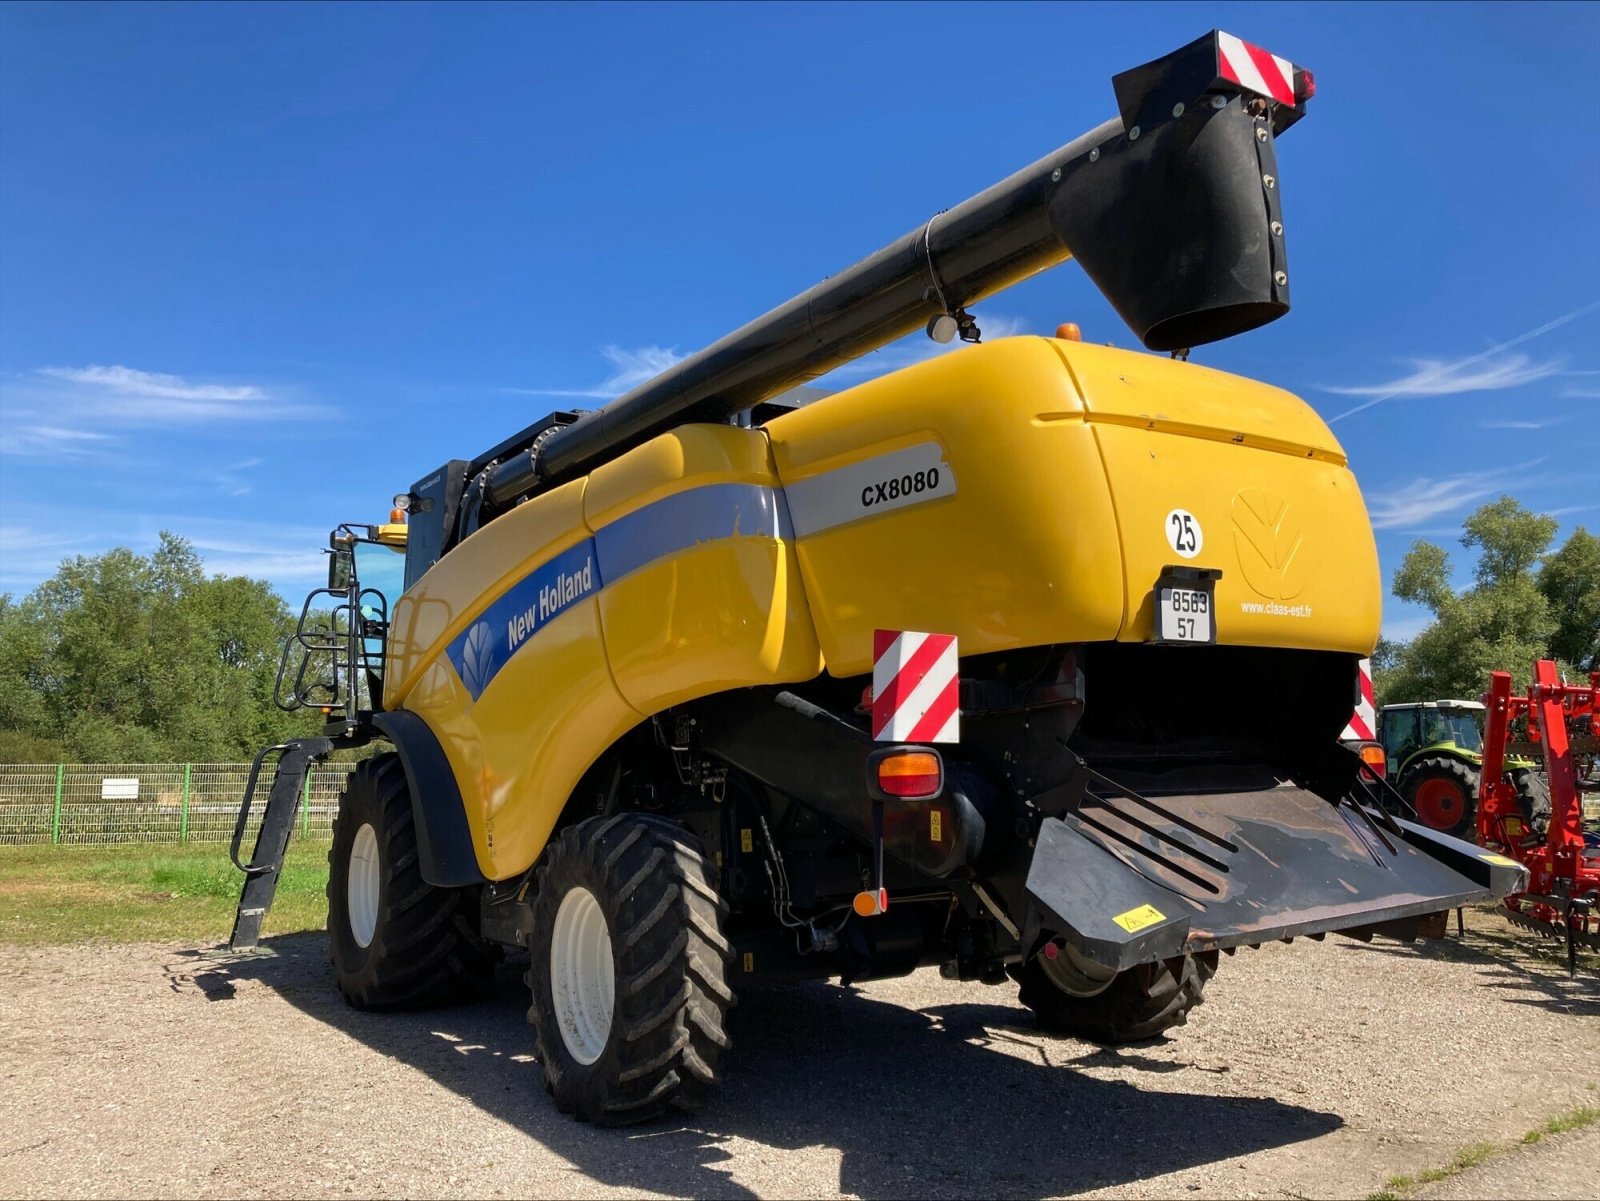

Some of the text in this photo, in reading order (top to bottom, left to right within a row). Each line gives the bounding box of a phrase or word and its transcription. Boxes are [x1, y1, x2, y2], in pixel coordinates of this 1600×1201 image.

[861, 467, 939, 507] CX8080
[1172, 514, 1196, 552] 25
[508, 556, 592, 651] New Holland
[1173, 591, 1207, 613] 8563
[1241, 601, 1312, 617] www.claas-est.fr
[1178, 618, 1195, 639] 57
